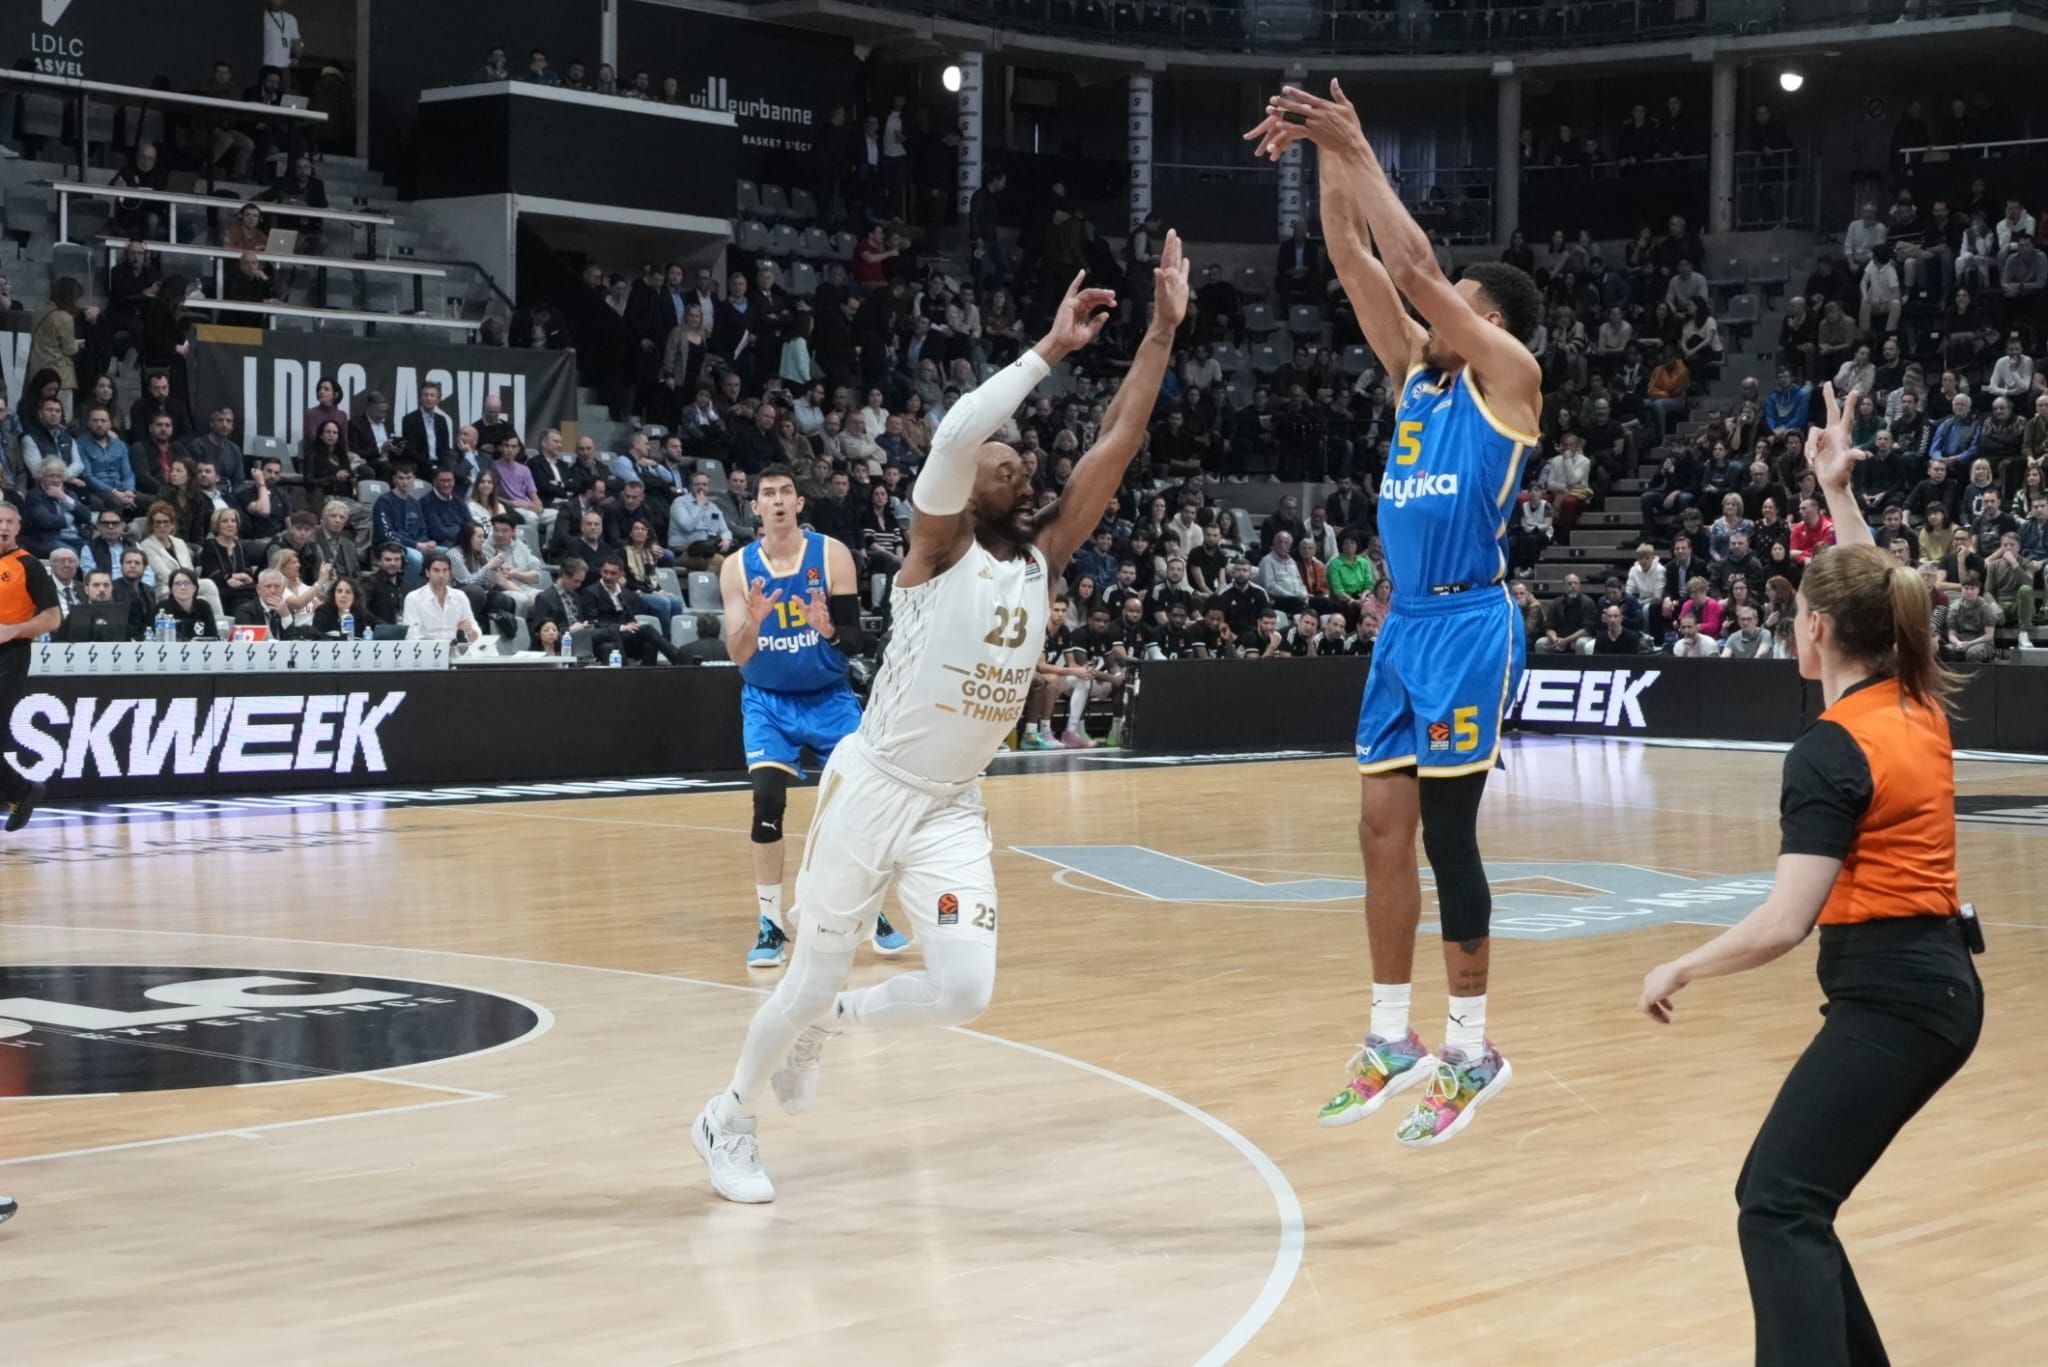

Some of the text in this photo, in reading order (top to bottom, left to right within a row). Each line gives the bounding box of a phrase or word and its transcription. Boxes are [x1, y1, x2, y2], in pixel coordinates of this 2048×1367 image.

[31, 32, 84, 57] LDLC
[34, 57, 84, 77] ASVEL
[742, 135, 781, 148] BASKET
[1396, 420, 1424, 465] 5
[774, 599, 808, 630] 15
[983, 606, 1028, 648] 23
[757, 629, 821, 653] Playtik
[974, 662, 1032, 685] SMART
[961, 680, 1017, 703] GOOD
[962, 700, 1021, 722] THINGS
[3, 693, 407, 782] SKWEEK
[1454, 706, 1479, 752] 5
[971, 903, 996, 931] 23
[1489, 905, 1655, 933] LDLC
[71, 996, 457, 1041] EXPERIENCE
